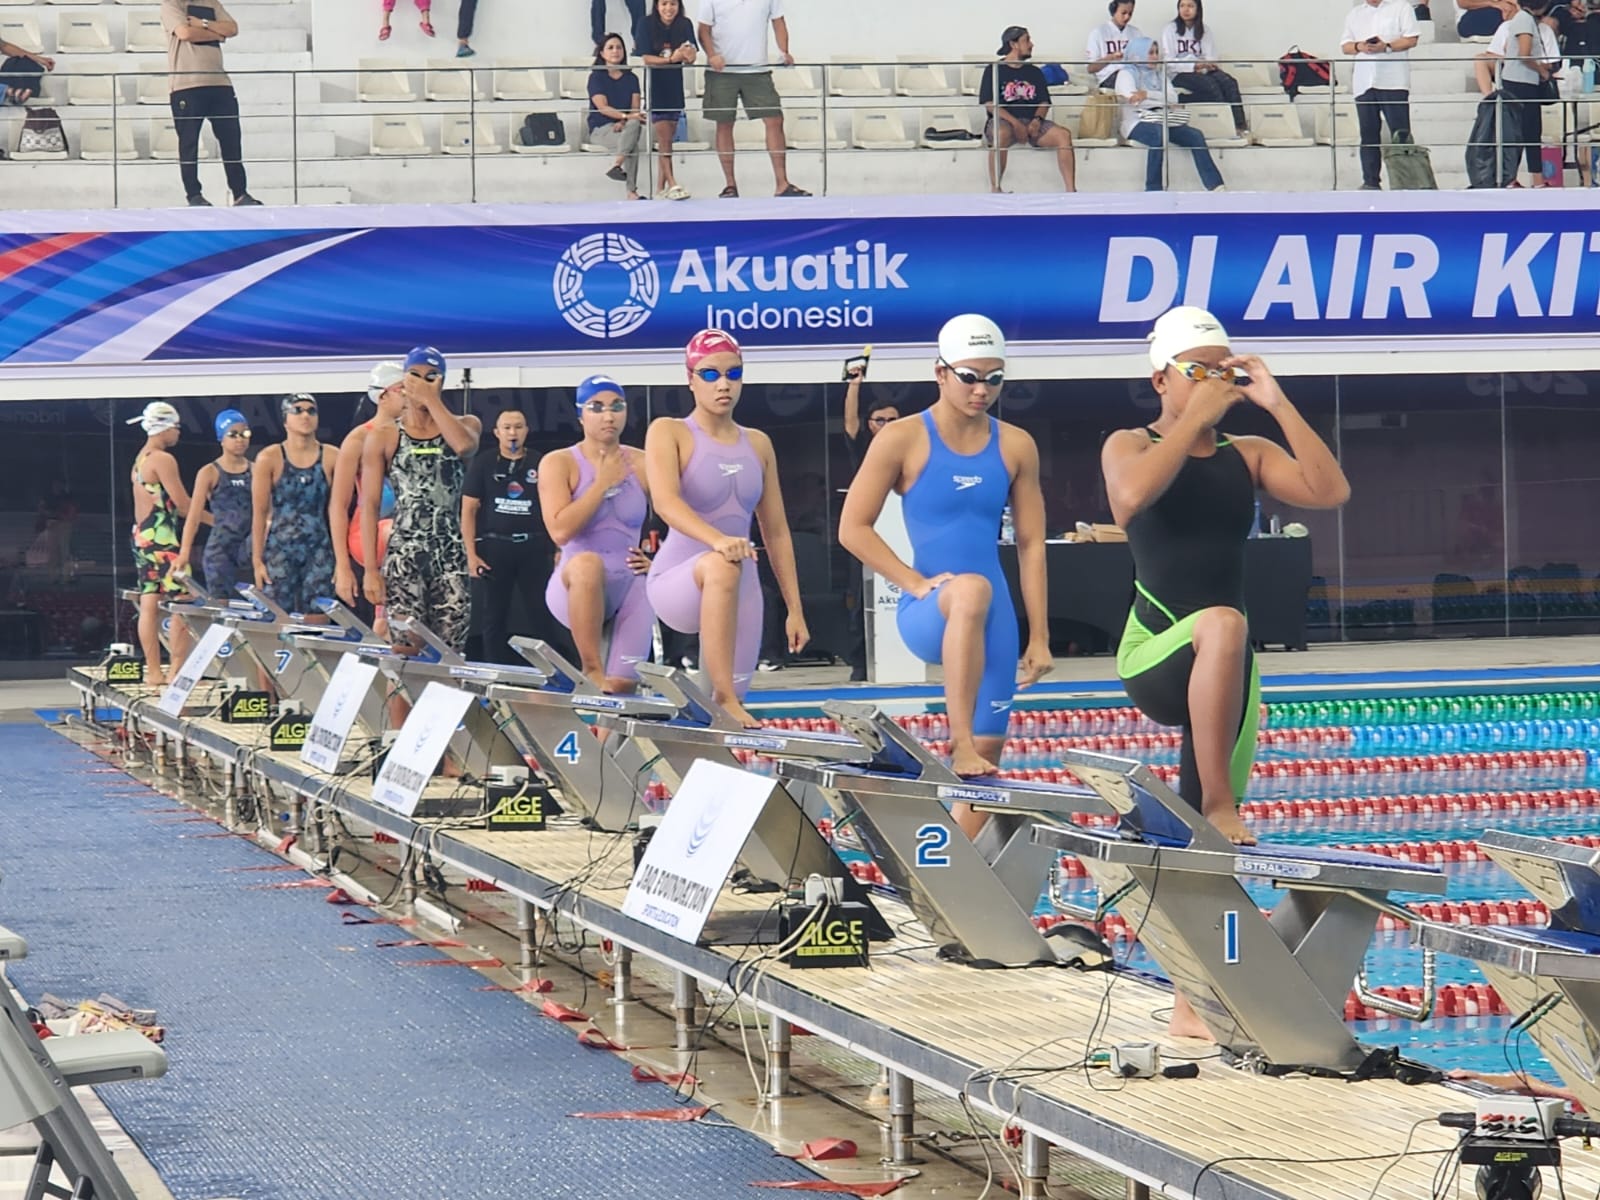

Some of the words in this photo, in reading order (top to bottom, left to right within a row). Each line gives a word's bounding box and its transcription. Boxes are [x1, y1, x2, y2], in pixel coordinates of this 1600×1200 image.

[670, 240, 909, 293] Akuatik
[1099, 235, 1218, 322] DI
[1243, 234, 1439, 320] AIR
[1472, 232, 1600, 318] KI
[707, 300, 873, 330] Indonesia
[878, 596, 897, 604] Aku
[109, 662, 140, 674] ALGE
[274, 650, 293, 674] 7
[233, 698, 268, 712] ALGE
[554, 731, 581, 764] 4
[495, 796, 542, 815] ALGE
[916, 824, 950, 867] 2
[800, 920, 863, 946] ALGE
